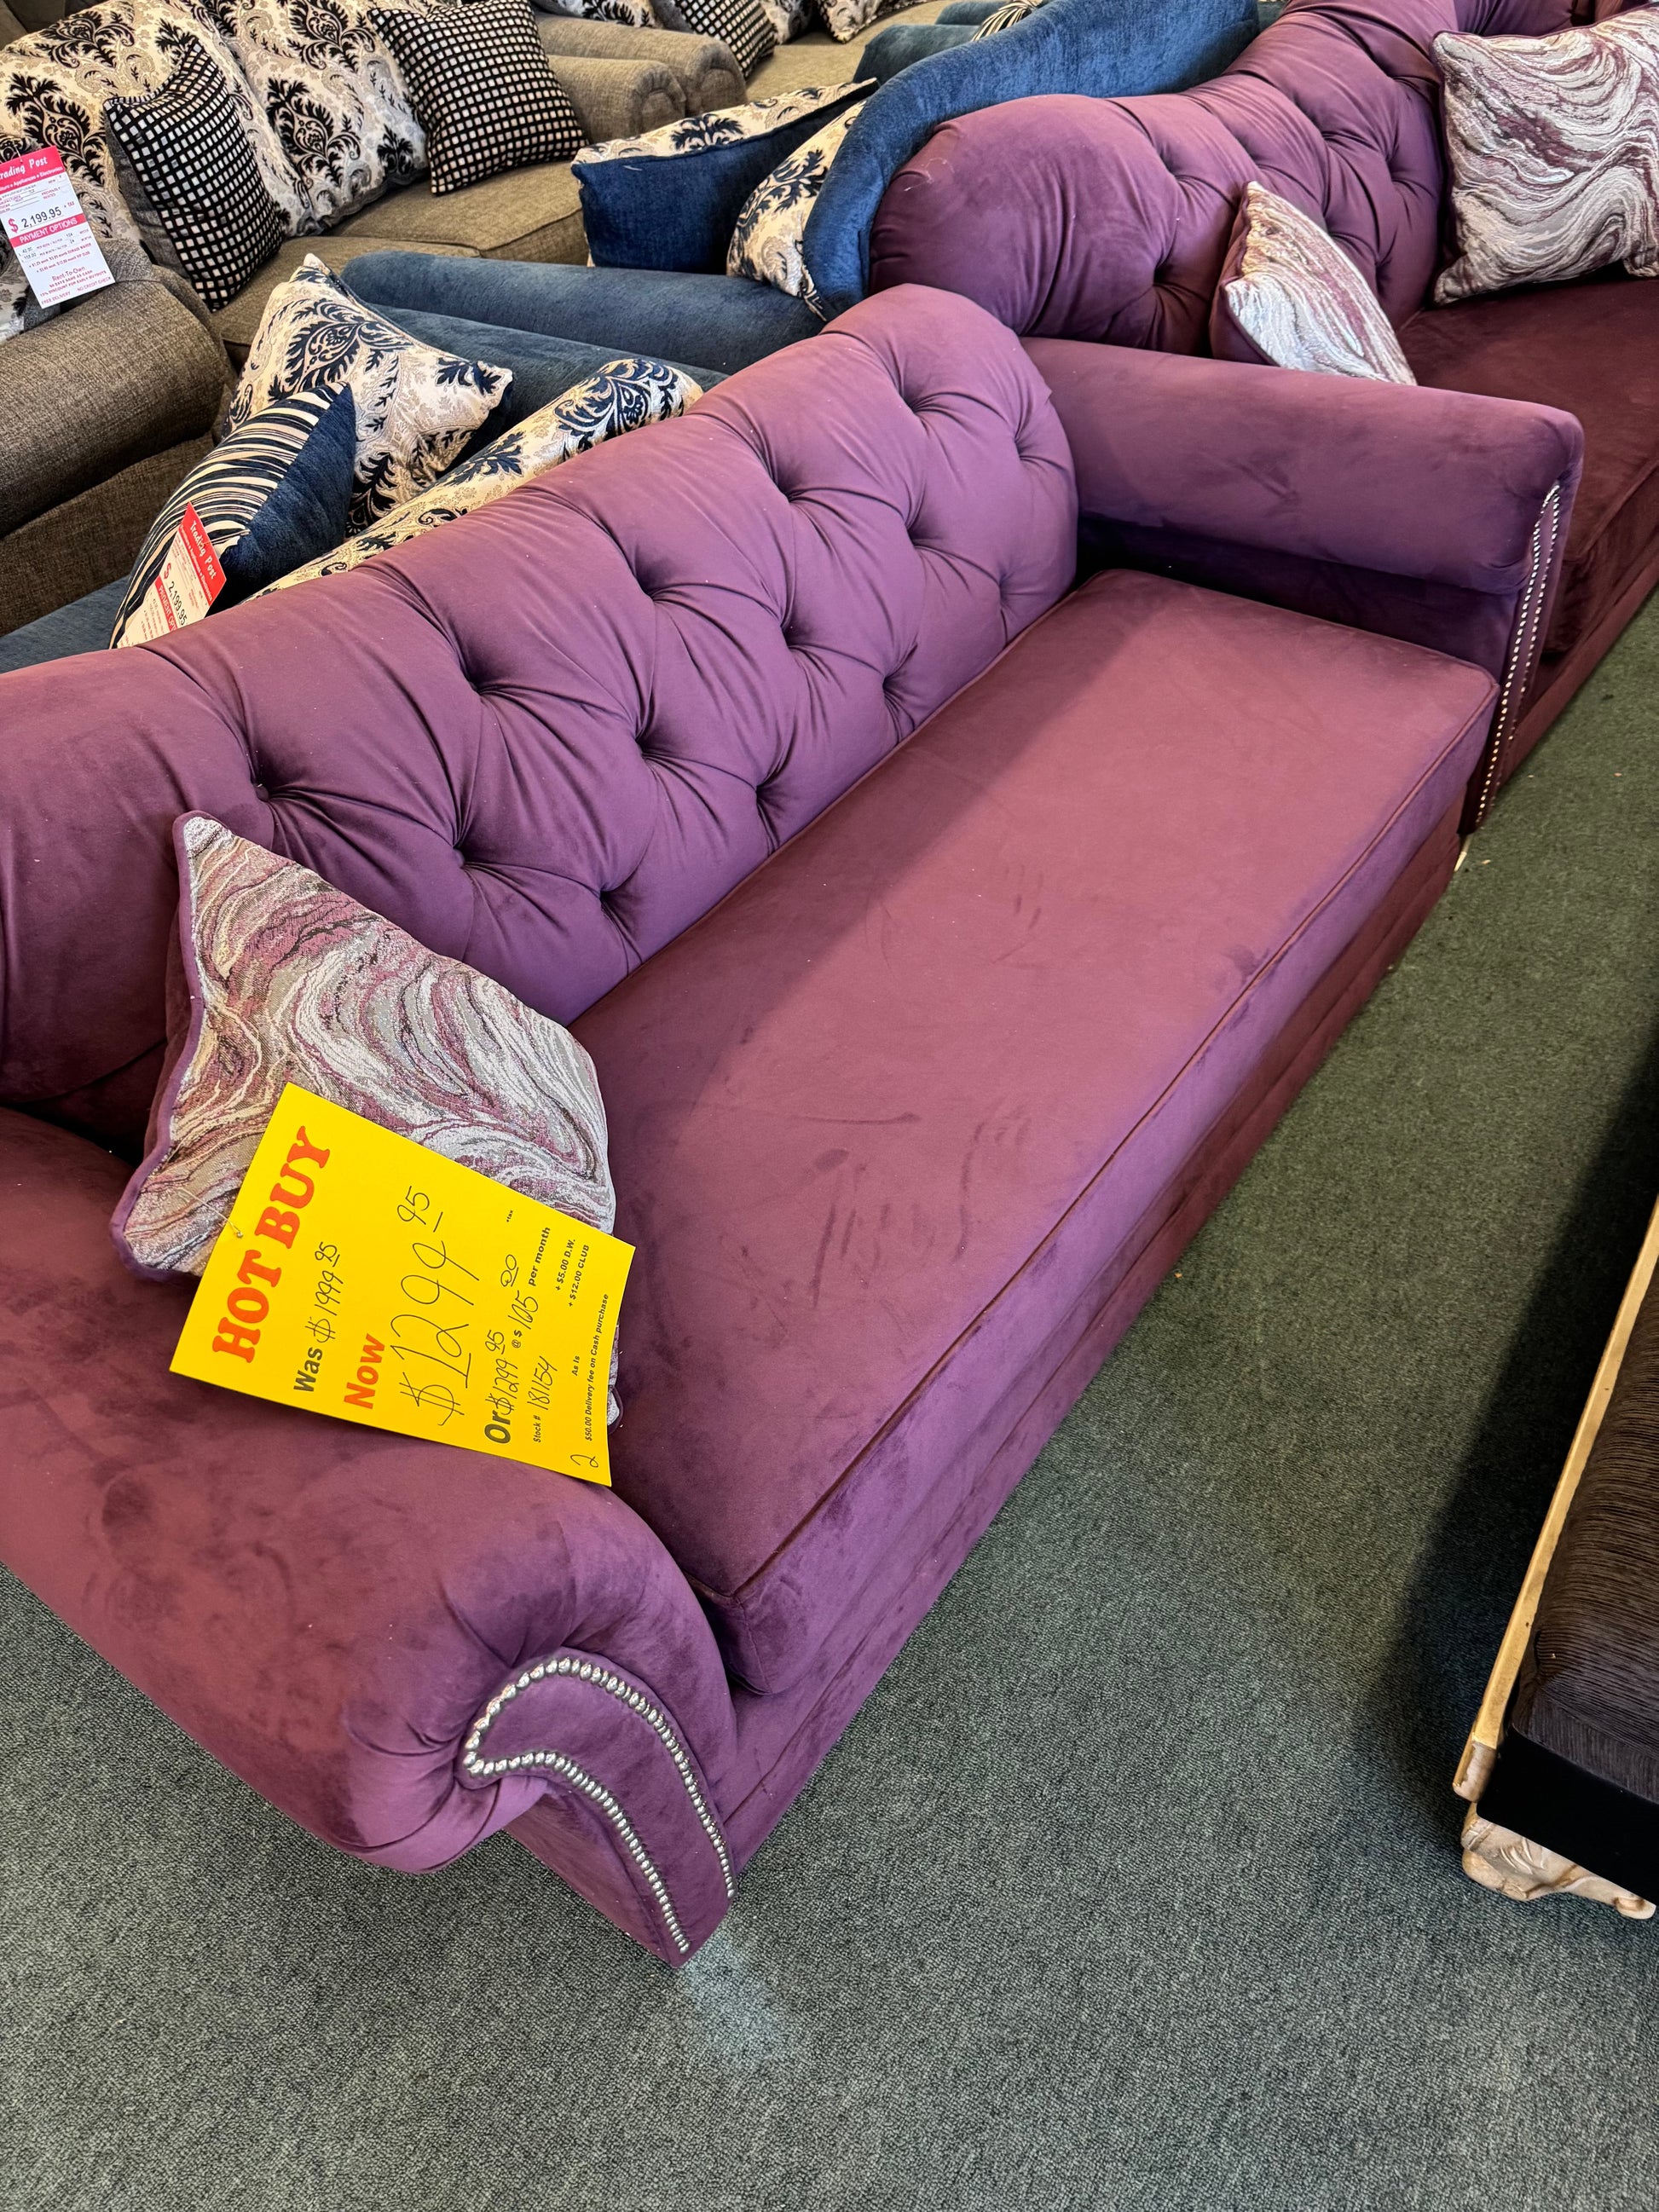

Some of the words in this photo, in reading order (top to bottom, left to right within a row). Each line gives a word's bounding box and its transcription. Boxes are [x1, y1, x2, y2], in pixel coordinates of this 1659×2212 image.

[0, 165, 26, 180] rading
[29, 157, 48, 169] Post
[8, 217, 19, 234] $
[21, 206, 61, 228] 2,199.95
[19, 228, 49, 244] PAYMENT
[49, 217, 78, 234] OPTIONS
[52, 266, 85, 281] Rent-To-Own
[189, 520, 206, 557] Trading
[205, 556, 217, 580] Post
[158, 584, 172, 615] PAYMENT
[168, 580, 188, 626] 2,199.95
[212, 1250, 282, 1363] HOT
[254, 1125, 331, 1249] BUY
[557, 1260, 569, 1285] $5.00
[564, 1239, 576, 1258] D.W.
[569, 1270, 583, 1301] $12.00
[577, 1245, 590, 1269] CLUB
[596, 1293, 609, 1334] purchase
[484, 1409, 512, 1444] Or
[528, 1265, 539, 1287] per
[535, 1227, 551, 1265] month
[591, 1331, 600, 1356] Cash
[293, 1347, 323, 1393] Was
[344, 1332, 386, 1409] Now
[571, 1366, 580, 1377] As
[573, 1355, 581, 1366] Is
[589, 1358, 597, 1368] on
[587, 1368, 595, 1386] fee
[585, 1386, 595, 1416] Delivery
[533, 1420, 542, 1443] Stock
